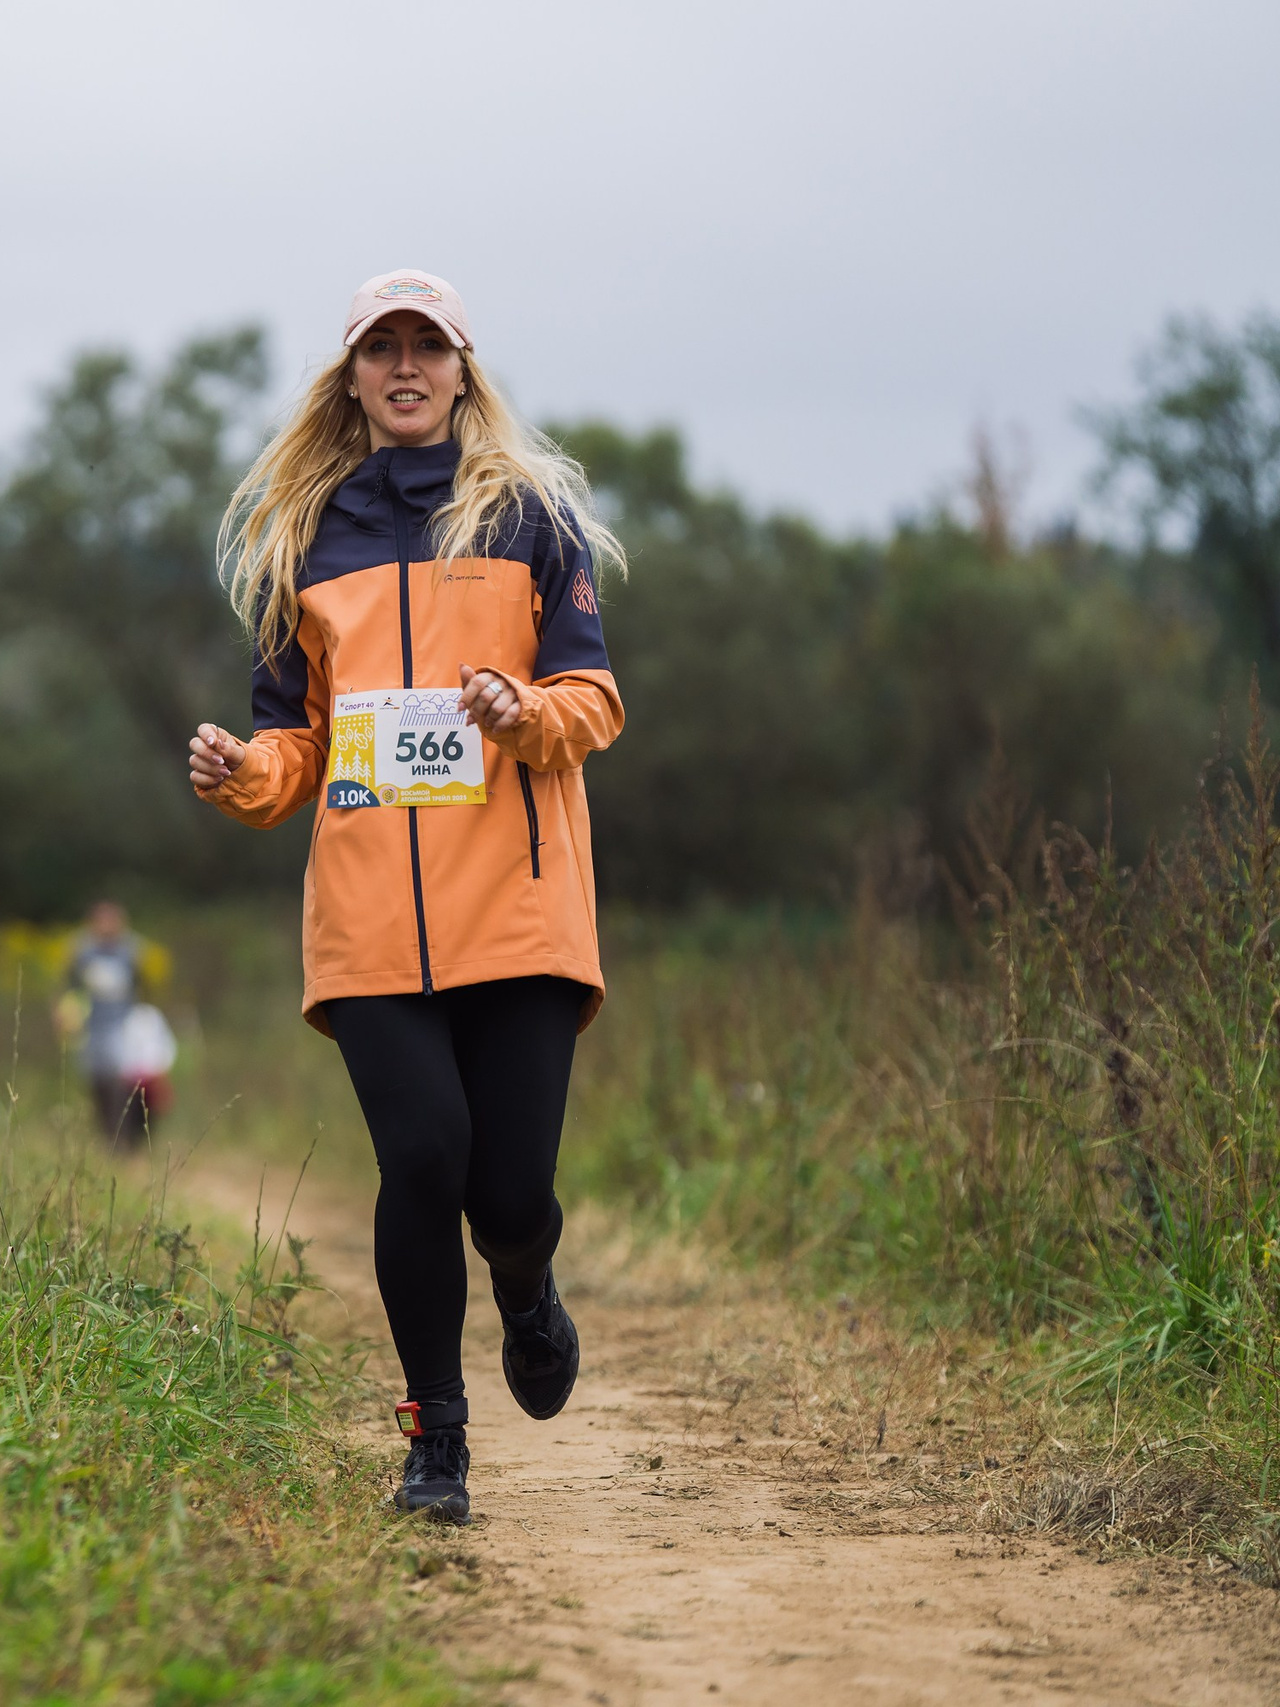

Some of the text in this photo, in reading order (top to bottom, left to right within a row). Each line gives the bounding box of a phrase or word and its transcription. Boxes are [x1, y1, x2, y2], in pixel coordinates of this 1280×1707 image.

[344, 702, 365, 711] СПОРТ
[395, 730, 464, 763] 566
[411, 764, 451, 776] ИННА
